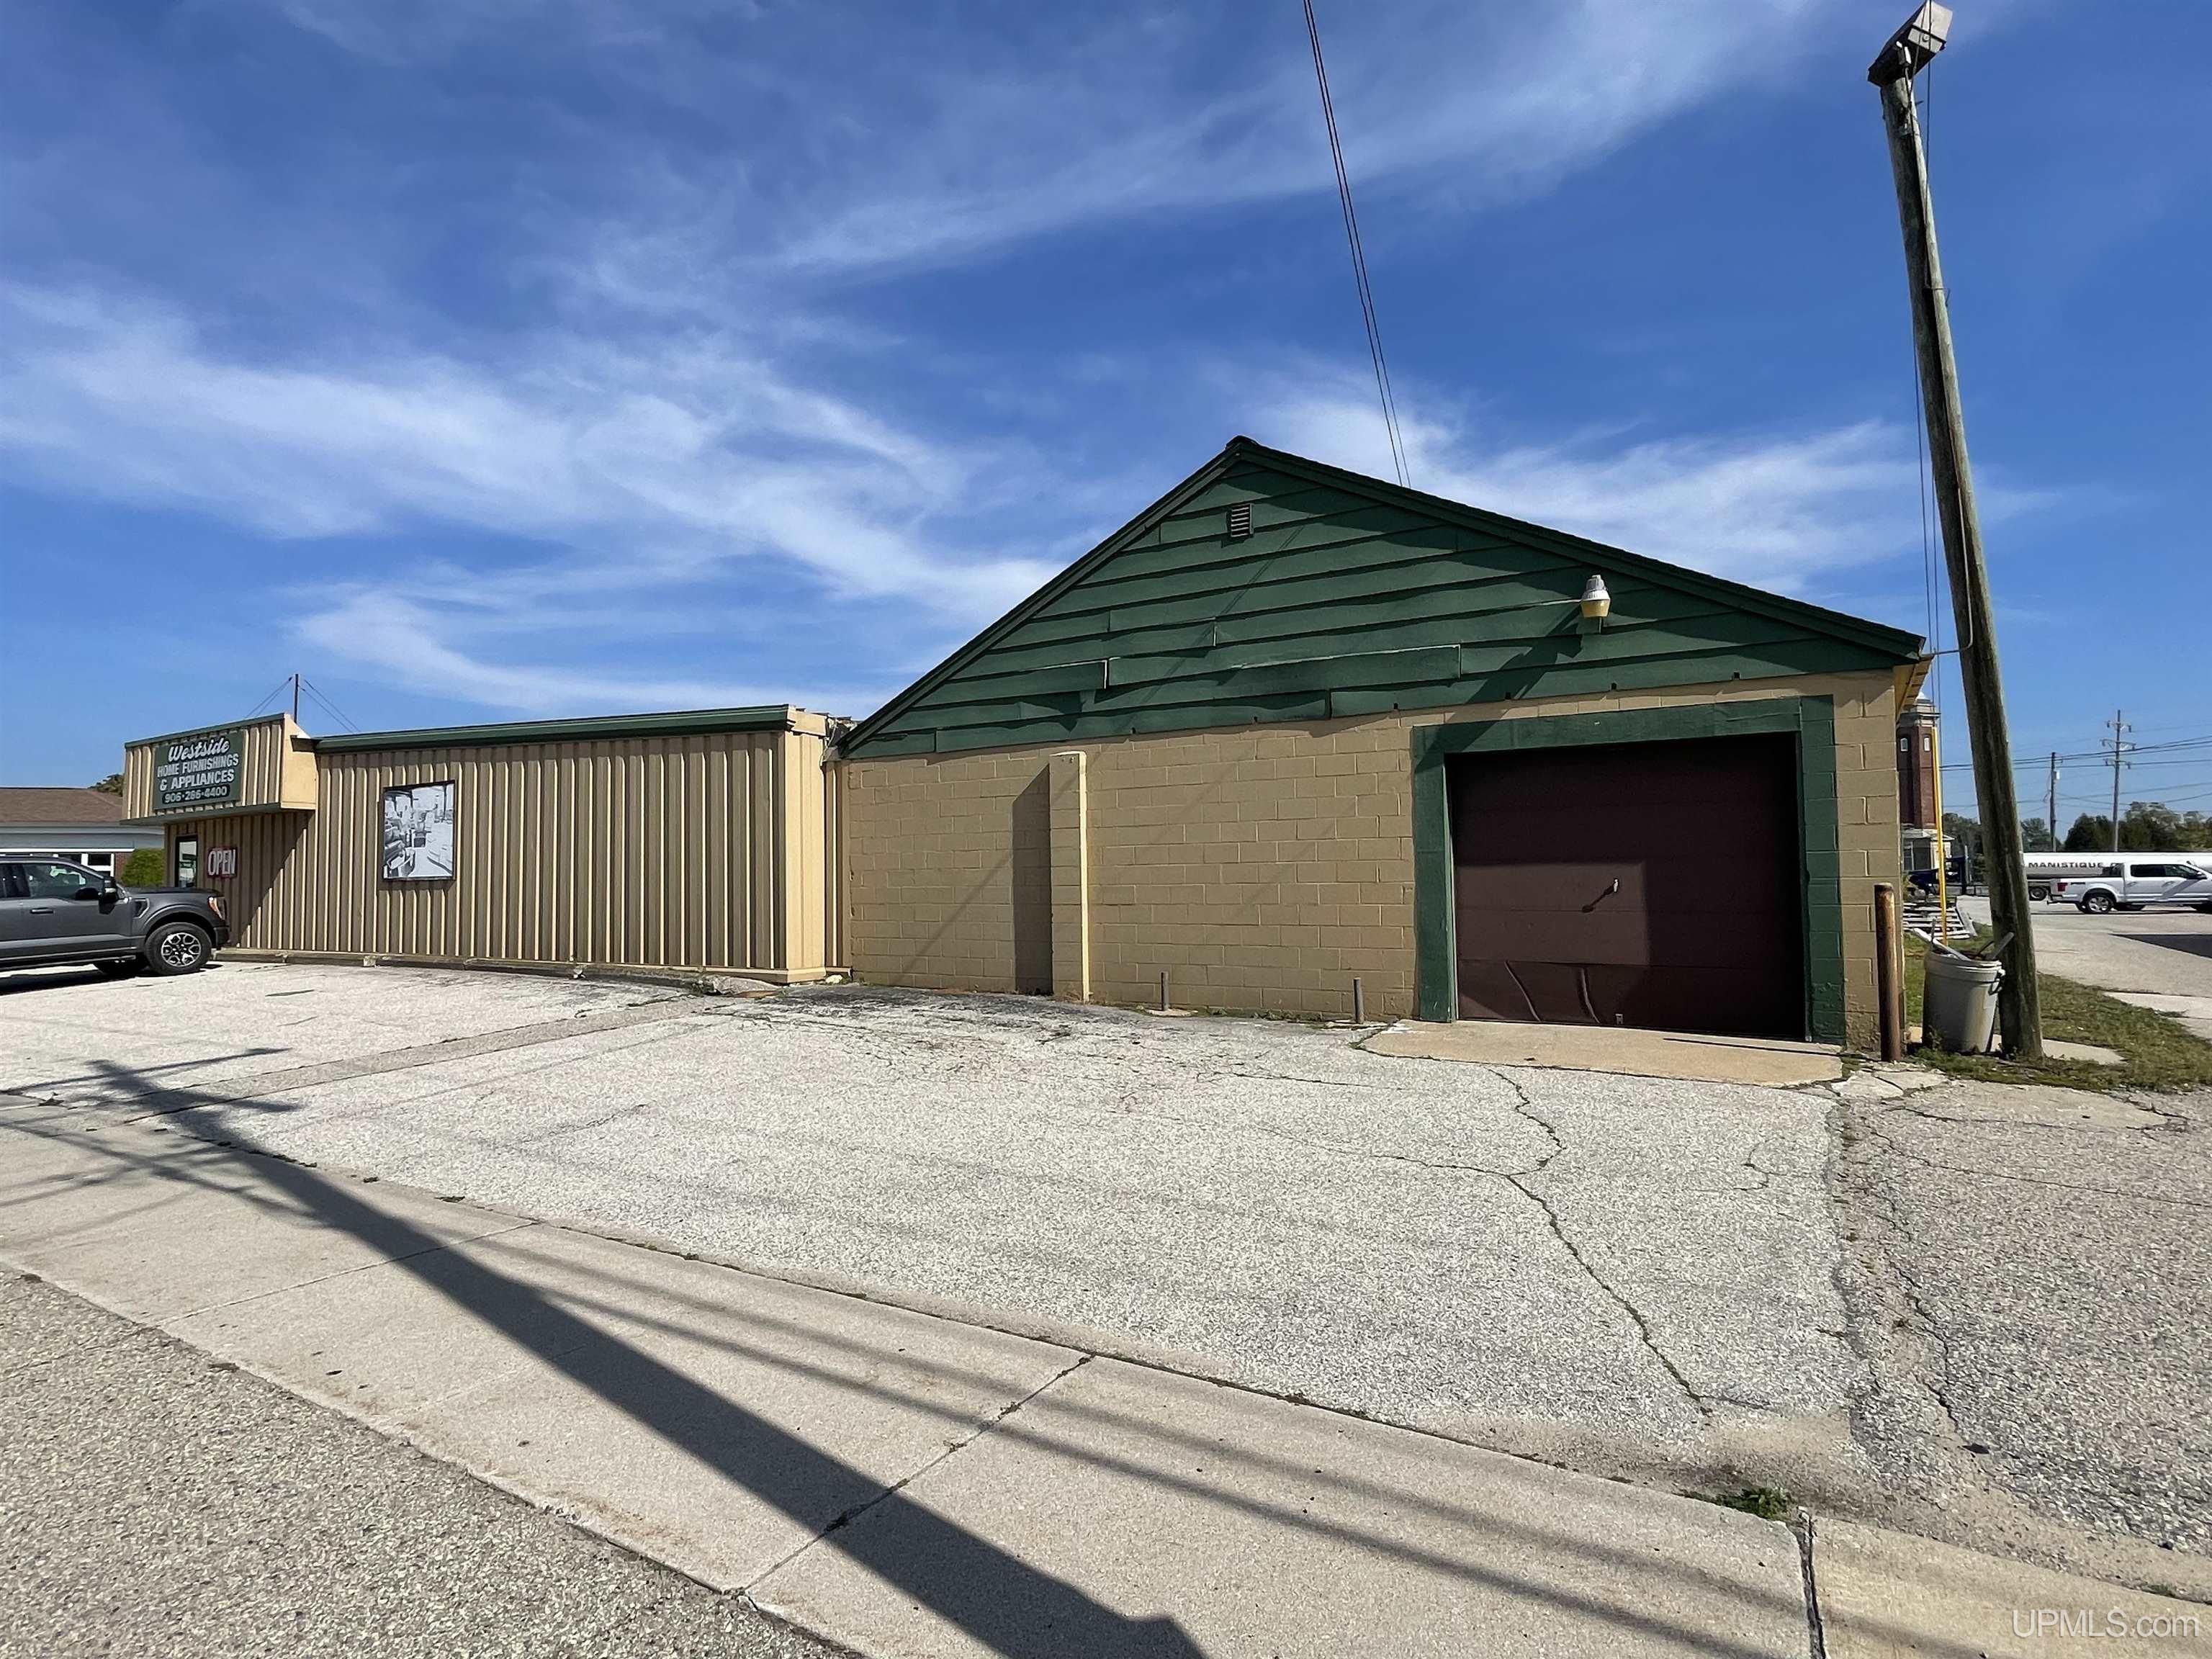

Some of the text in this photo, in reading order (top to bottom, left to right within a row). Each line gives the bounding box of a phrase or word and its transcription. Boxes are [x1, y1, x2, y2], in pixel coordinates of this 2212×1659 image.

[168, 737, 230, 762] Westside
[157, 753, 239, 778] HOME FURNISHINGS
[160, 769, 235, 791] & APPLIANCES
[208, 849, 236, 876] OPEN
